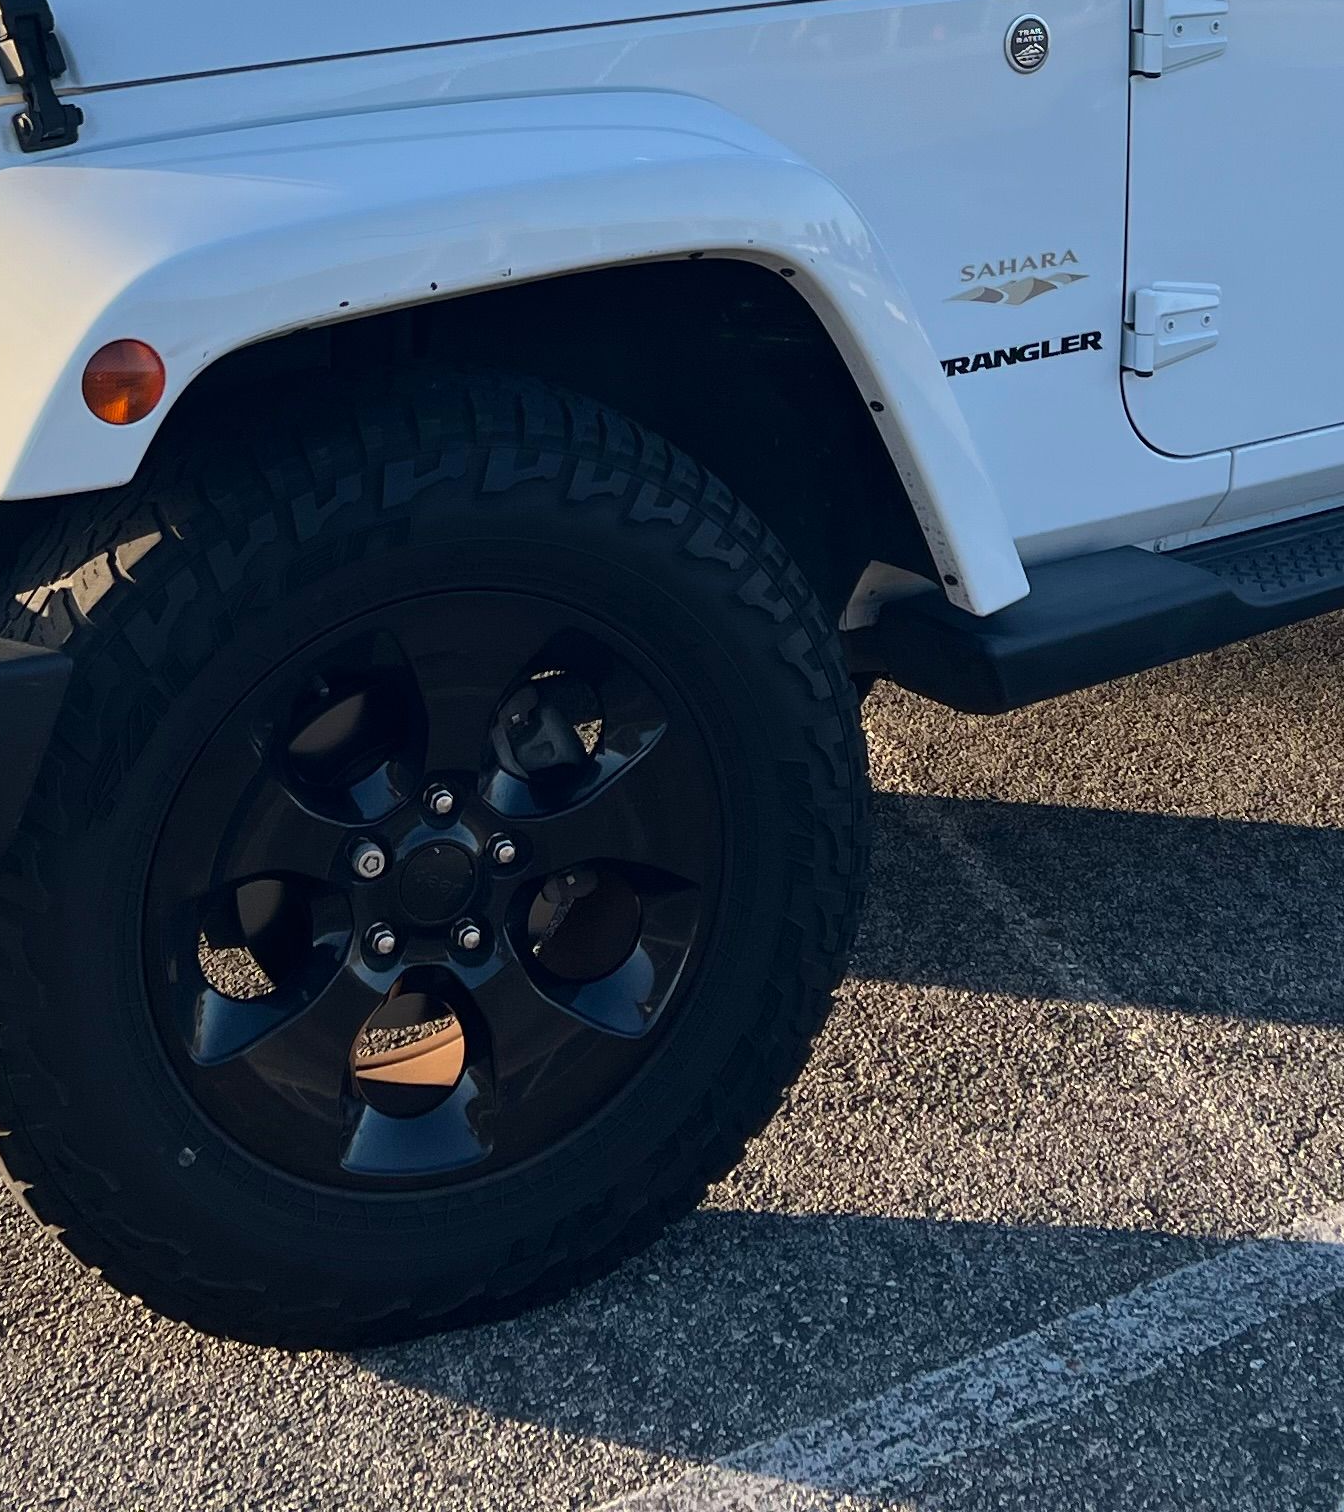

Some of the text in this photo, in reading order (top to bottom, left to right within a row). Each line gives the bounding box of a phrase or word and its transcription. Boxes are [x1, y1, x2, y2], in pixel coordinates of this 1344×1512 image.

[1018, 28, 1043, 36] TRAIL
[1016, 35, 1044, 43] RATED
[960, 249, 1079, 282] SAHARA
